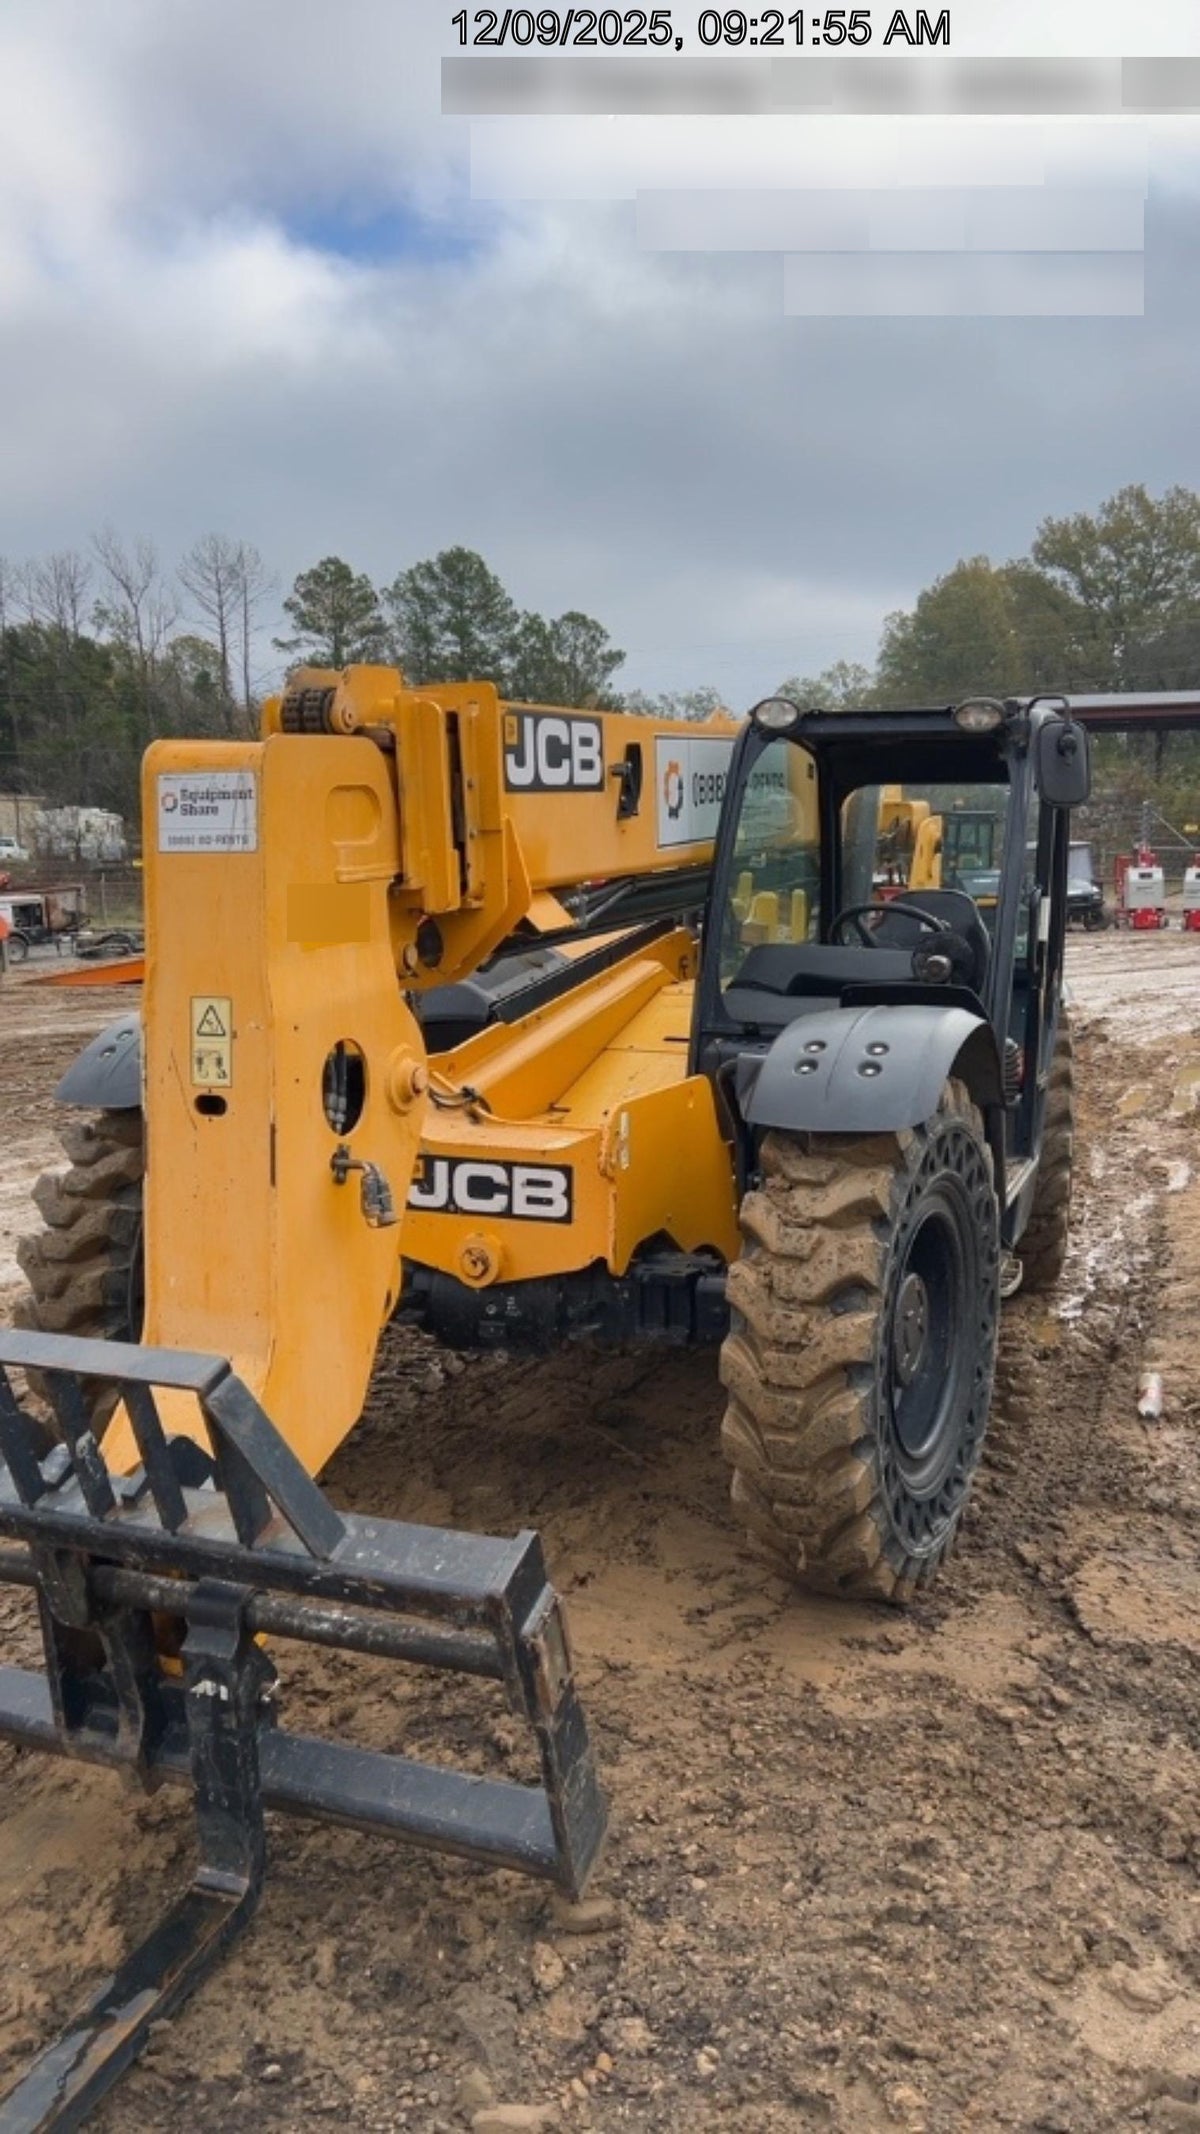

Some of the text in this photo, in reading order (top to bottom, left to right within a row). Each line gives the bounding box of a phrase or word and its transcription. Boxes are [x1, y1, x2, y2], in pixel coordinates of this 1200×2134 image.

[506, 716, 602, 786] JCB
[180, 788, 254, 804] Equipment
[180, 804, 218, 816] Share
[408, 1160, 569, 1218] JCB
